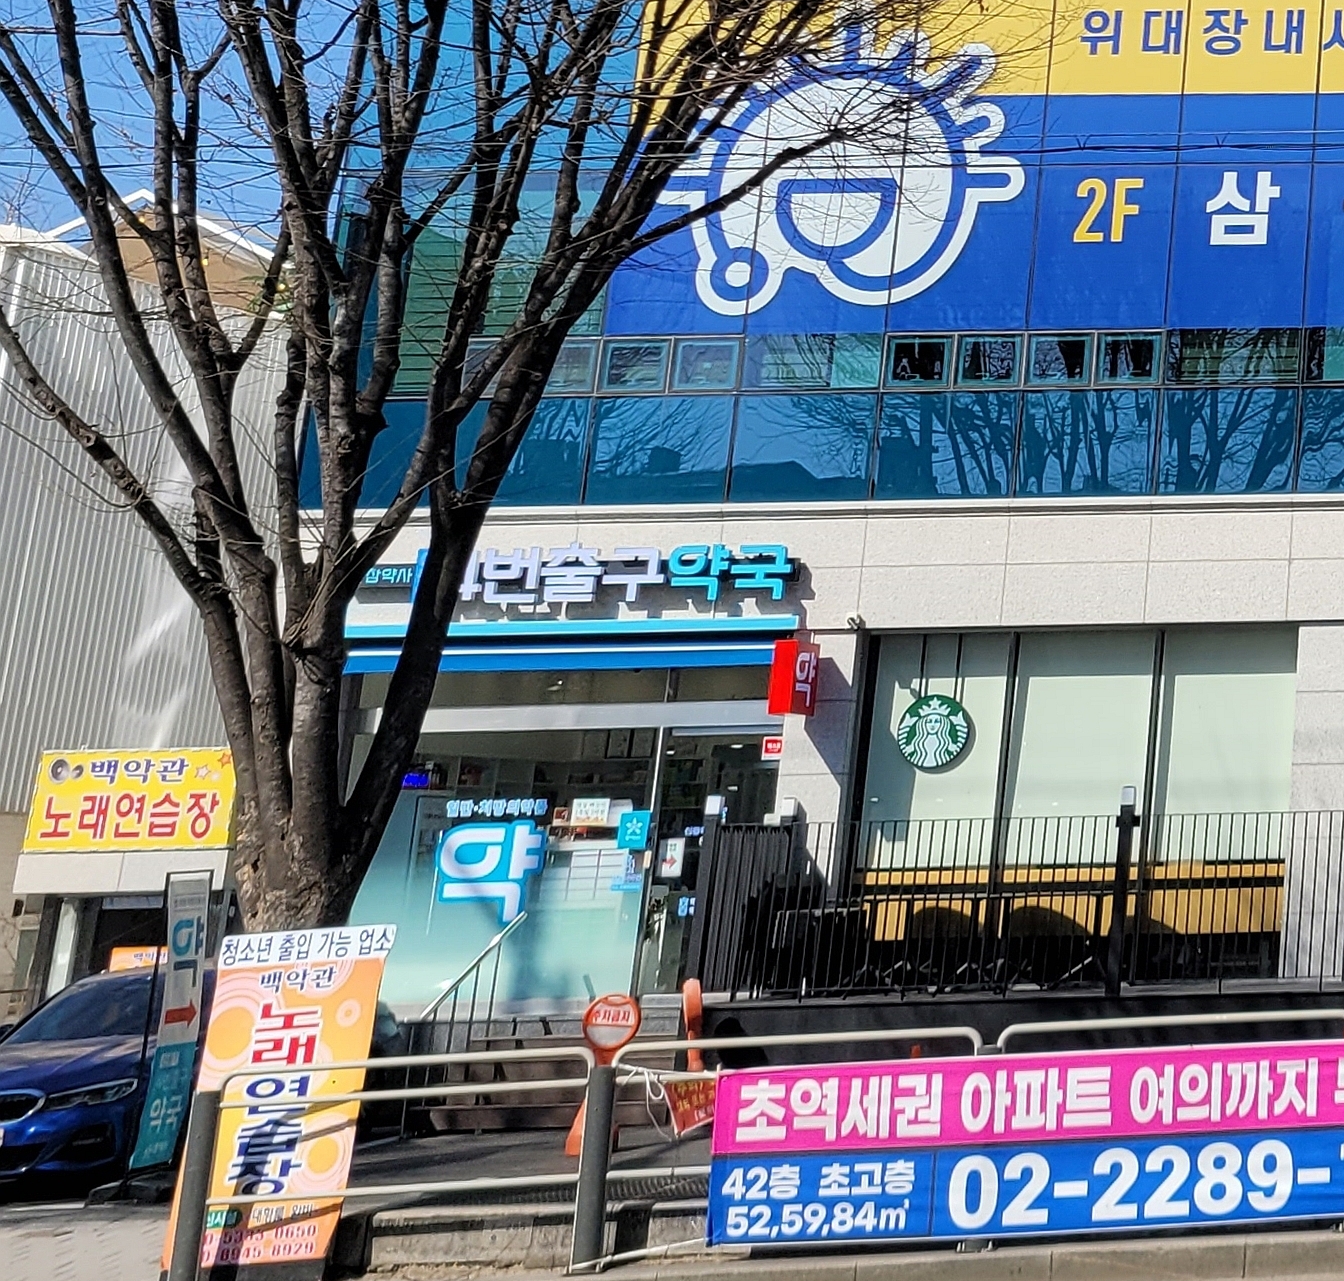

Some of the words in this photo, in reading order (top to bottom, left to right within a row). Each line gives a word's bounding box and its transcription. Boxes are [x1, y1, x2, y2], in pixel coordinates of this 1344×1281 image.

[1072, 177, 1144, 244] 2F
[795, 651, 817, 707] 약
[90, 757, 190, 784] 백악관
[39, 791, 221, 840] 노래연습장
[440, 824, 542, 923] 약
[222, 936, 274, 967] 청소년
[278, 932, 314, 962] 출입
[317, 930, 352, 959] 가능
[358, 927, 393, 956] 업소
[259, 965, 337, 994] 백악관
[735, 1071, 943, 1143] 초역세권
[960, 1065, 1113, 1135] 아파트
[1129, 1057, 1319, 1124] 여의까지
[721, 1163, 800, 1201] 42층
[818, 1159, 916, 1198] 초고층
